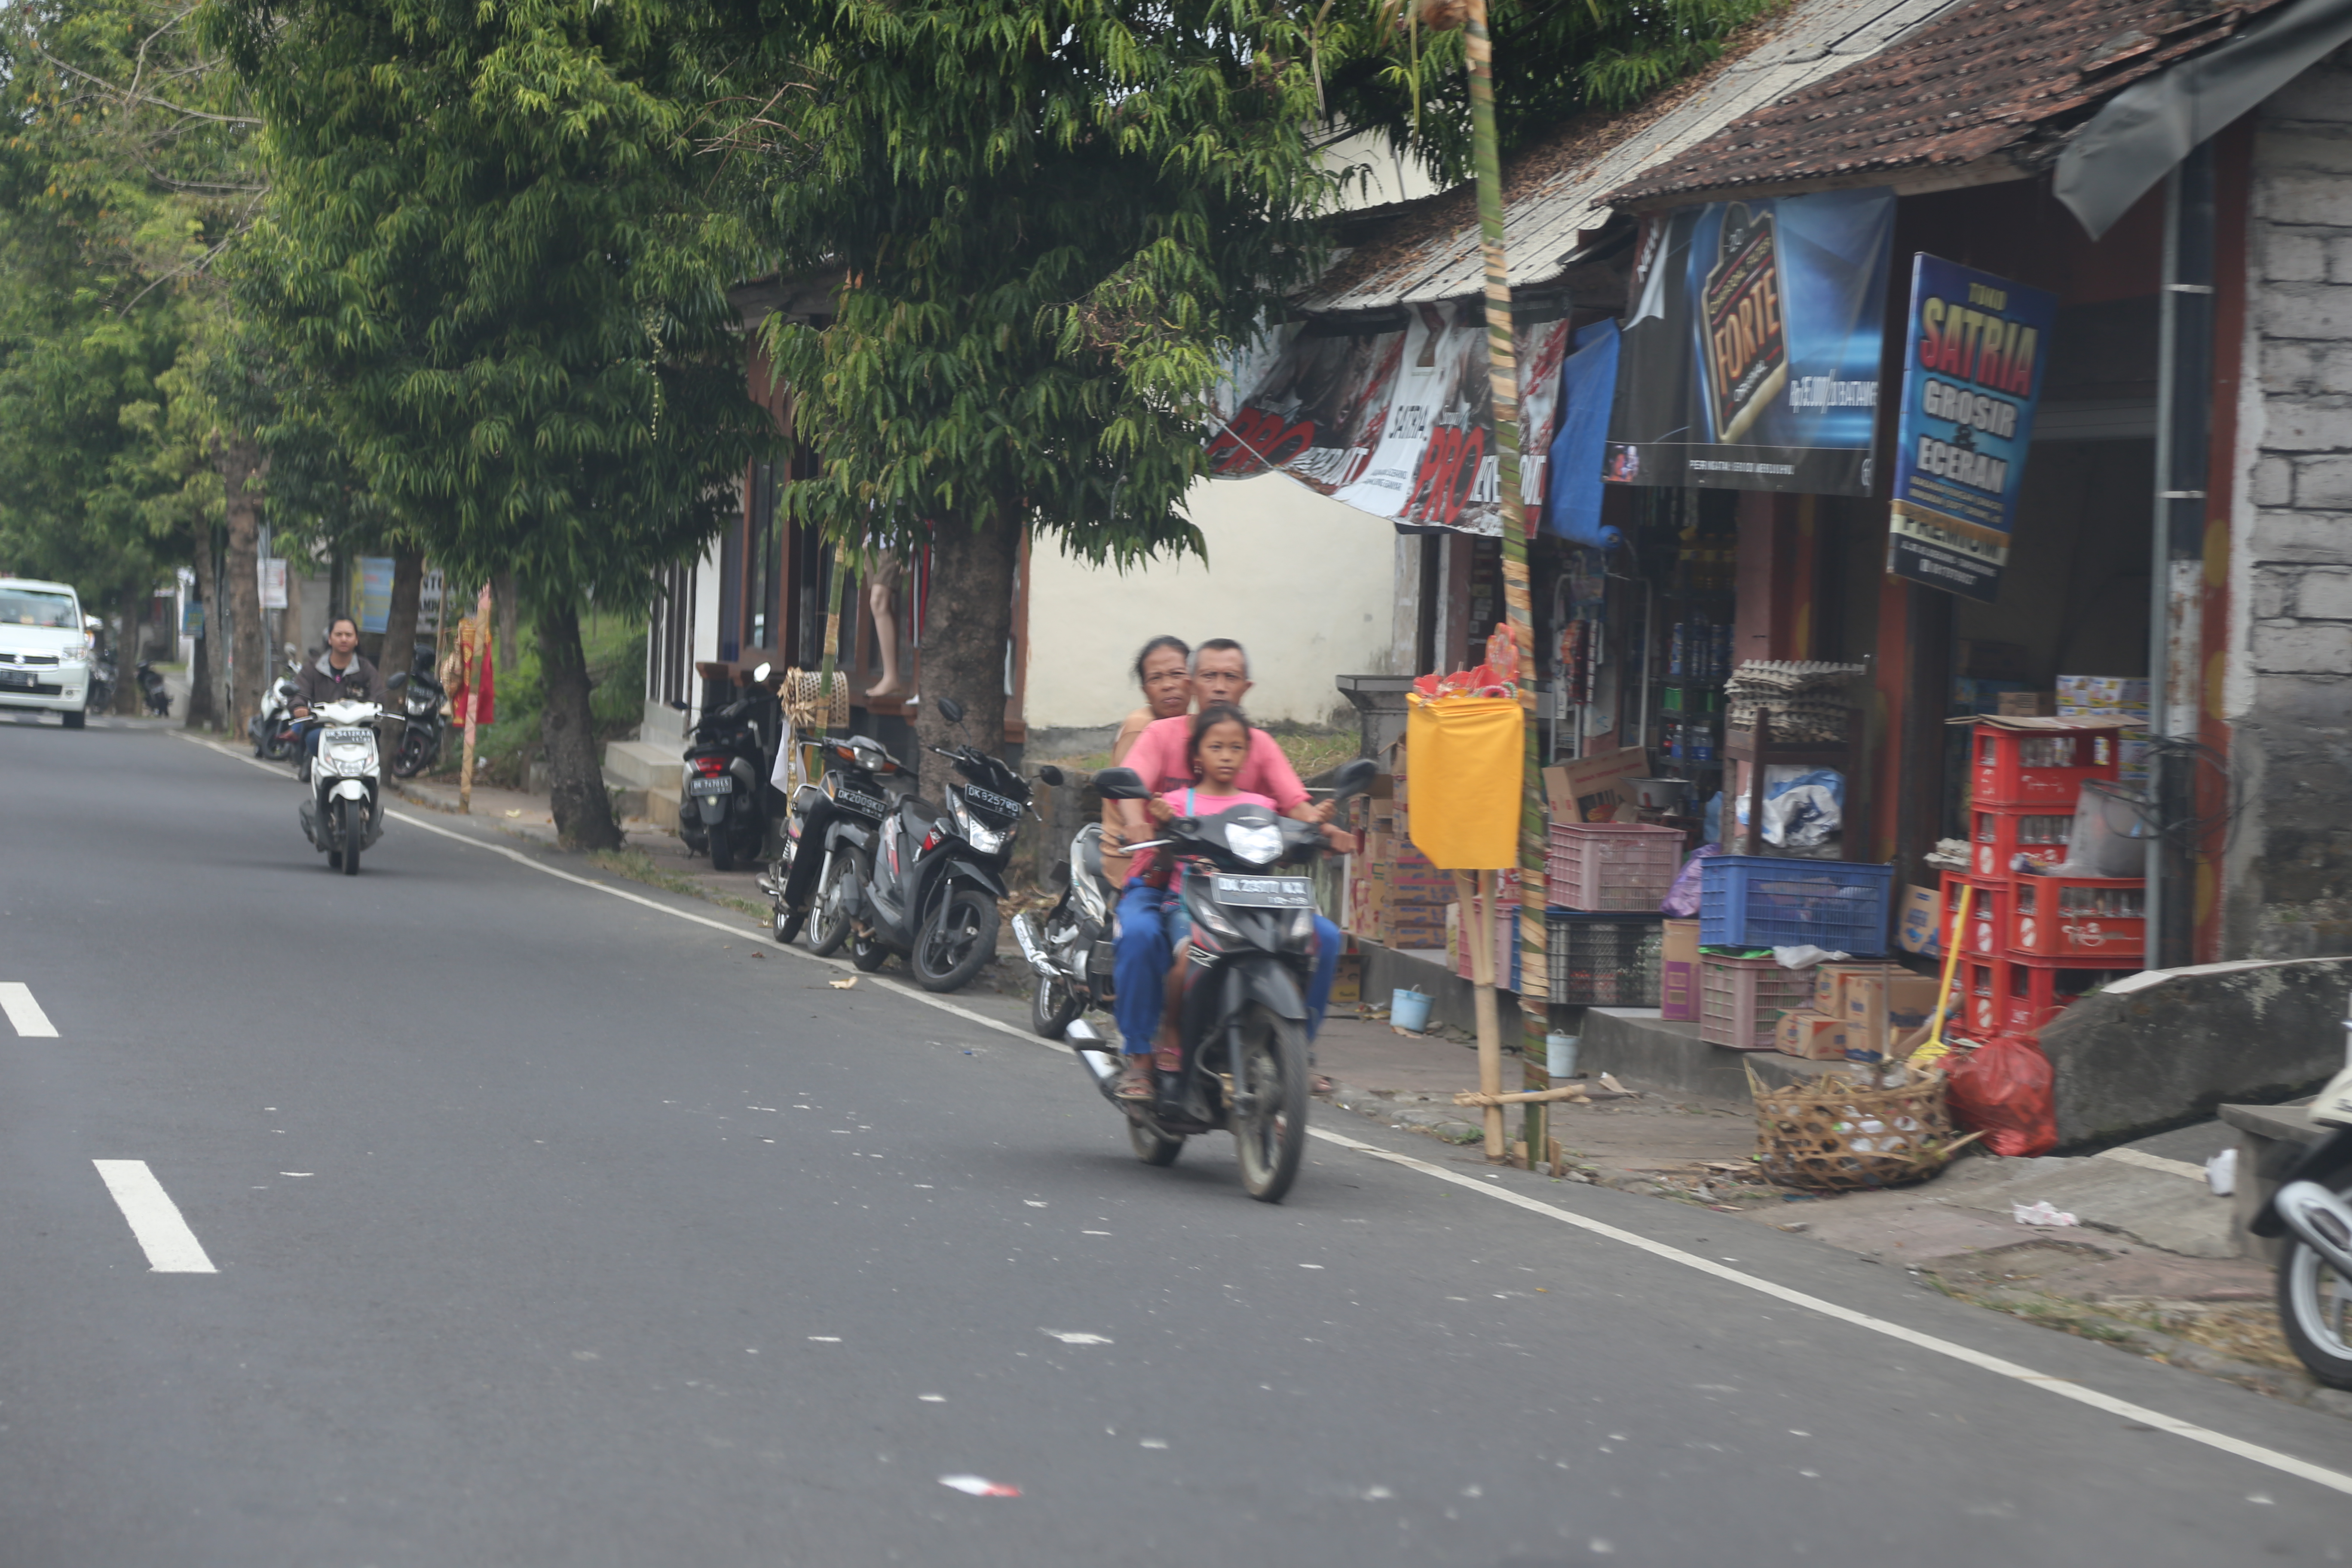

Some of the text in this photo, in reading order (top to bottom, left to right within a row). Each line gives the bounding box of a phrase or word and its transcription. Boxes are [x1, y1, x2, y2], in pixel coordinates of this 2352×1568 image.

[1714, 267, 1780, 397] FORTE
[1920, 297, 2038, 395] SATRIA
[1923, 380, 2018, 438] GROSIR
[1400, 426, 1484, 524] PRO
[1917, 436, 2008, 494] ECERAN
